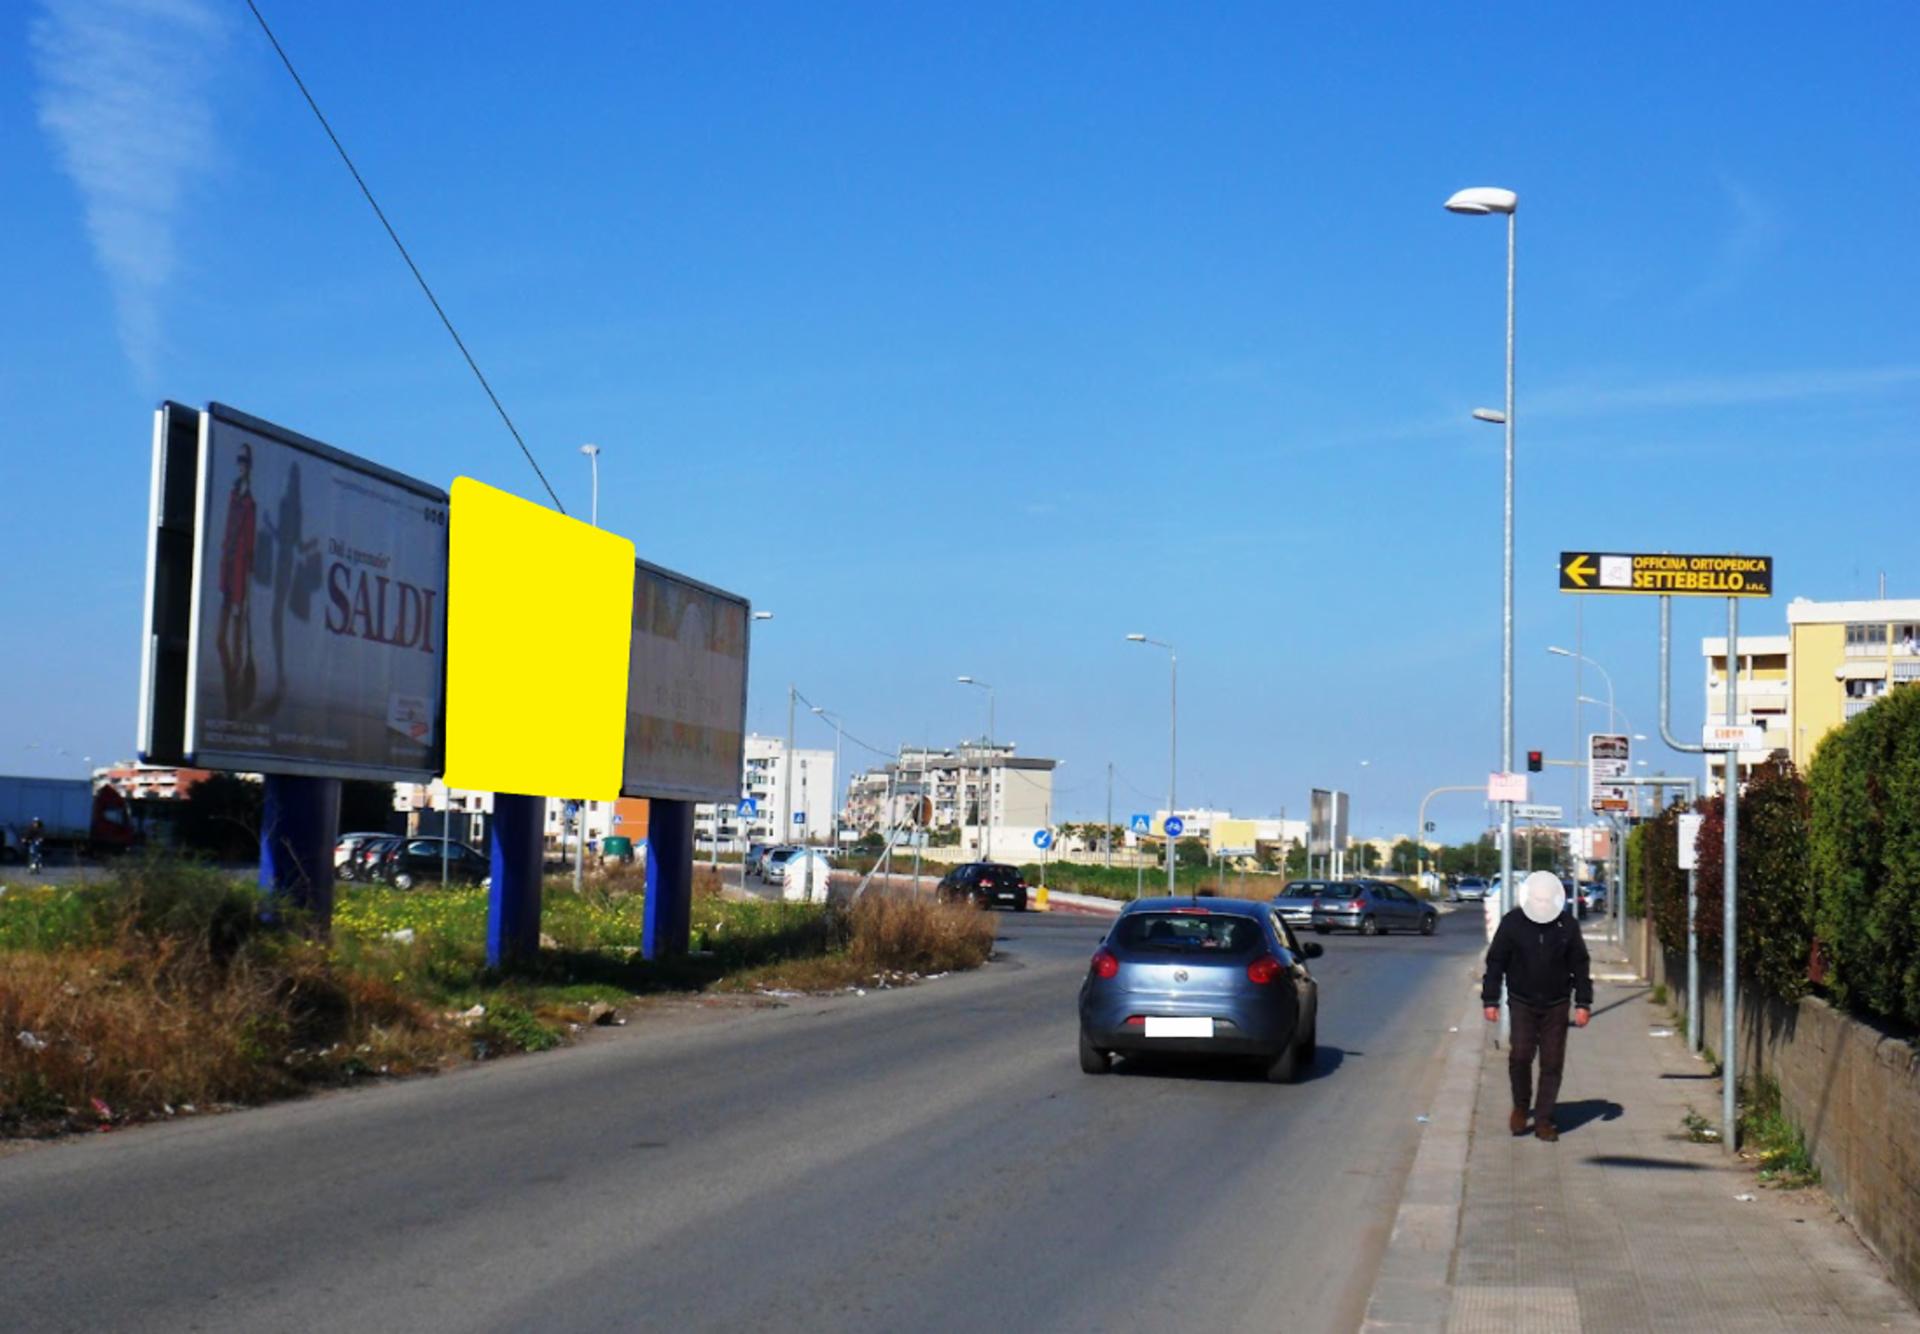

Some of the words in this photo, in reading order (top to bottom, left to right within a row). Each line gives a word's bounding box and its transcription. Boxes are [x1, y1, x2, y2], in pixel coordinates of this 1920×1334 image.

[1633, 556, 1688, 570] OFFICINA
[1690, 558, 1766, 572] ORTOPEDICA
[1633, 570, 1744, 590] SETTEBELLO
[325, 562, 437, 654] SALDI
